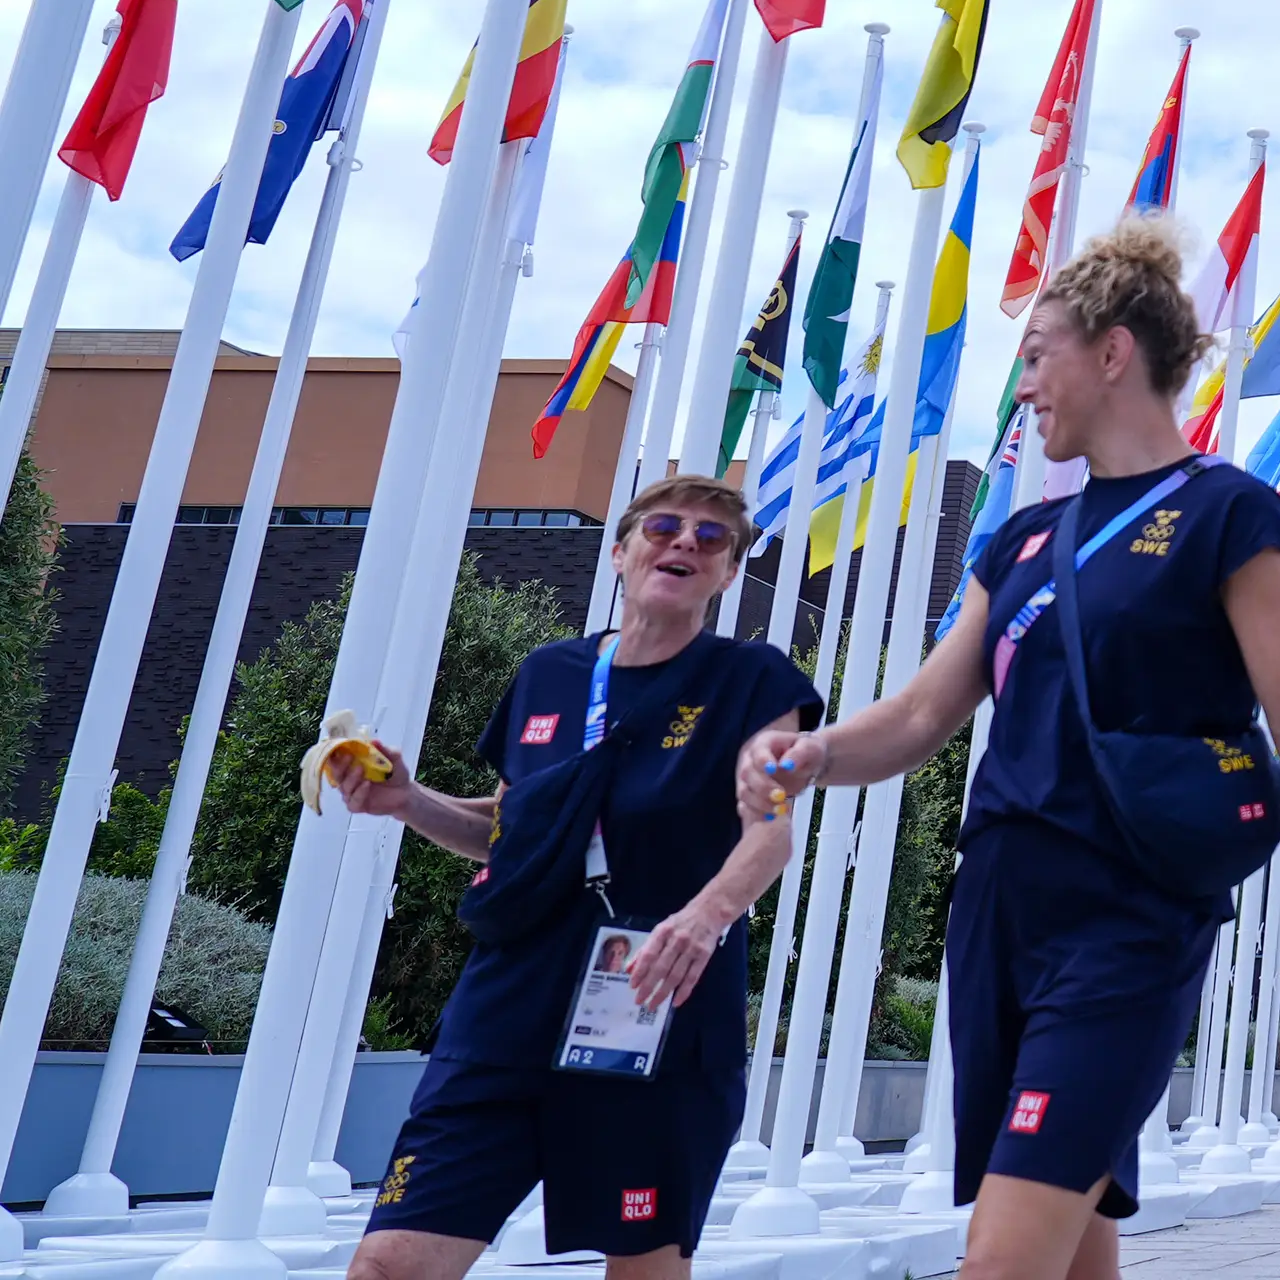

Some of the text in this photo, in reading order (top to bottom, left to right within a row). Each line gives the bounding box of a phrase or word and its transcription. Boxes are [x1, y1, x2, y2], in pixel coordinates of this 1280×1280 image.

[1129, 538, 1171, 556] SWE
[530, 718, 554, 730] UNI
[525, 729, 551, 742] QLO
[1218, 754, 1255, 774] SWE
[1012, 1110, 1039, 1129] QLO
[625, 1192, 650, 1205] UNI
[624, 1204, 652, 1219] QLO
